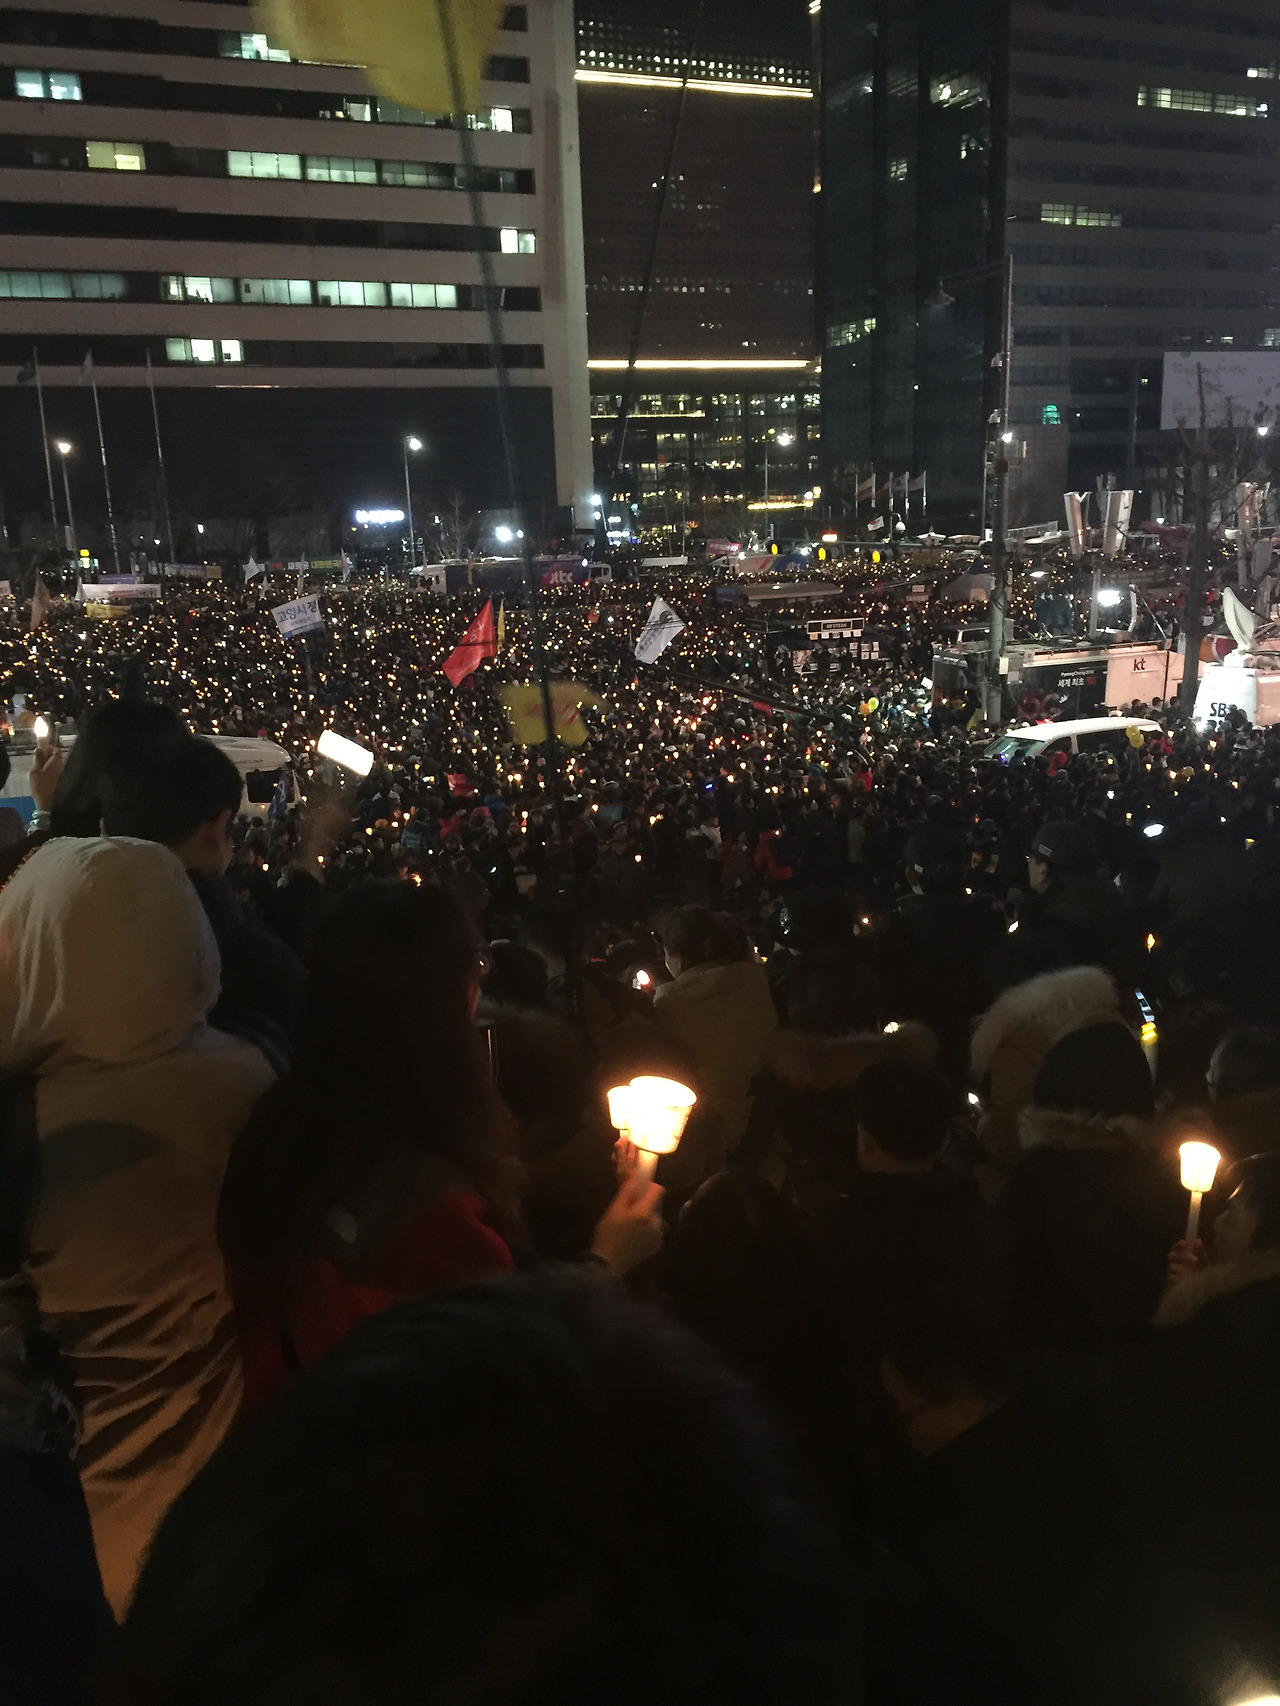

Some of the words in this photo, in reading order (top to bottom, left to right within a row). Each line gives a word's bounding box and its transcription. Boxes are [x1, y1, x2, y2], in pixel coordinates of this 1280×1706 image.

[550, 570, 573, 584] jtbc
[1134, 658, 1146, 671] kt
[1058, 679, 1071, 687] 세계
[1072, 677, 1085, 686] 최초
[1210, 702, 1228, 718] SB
